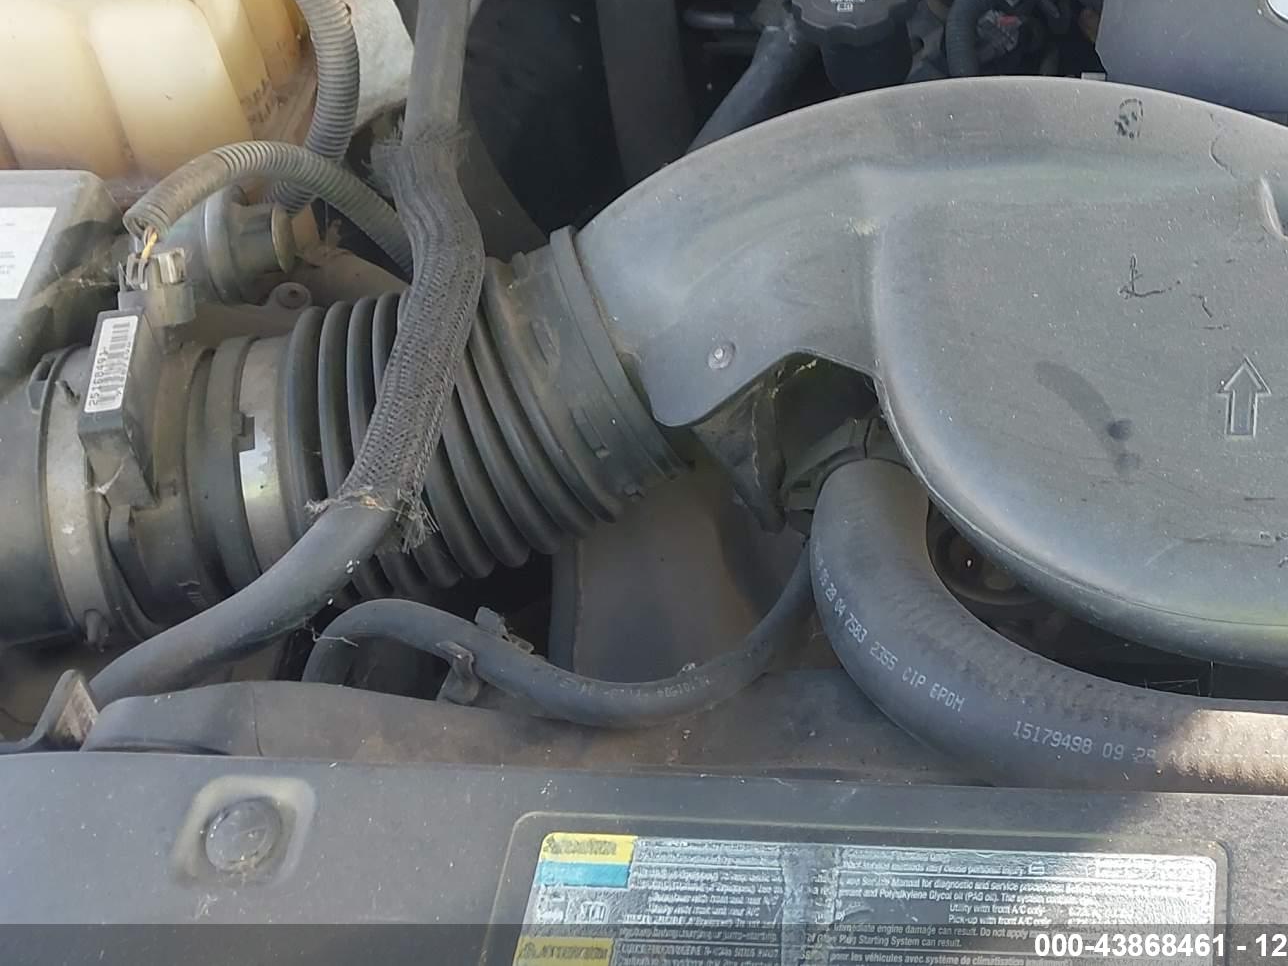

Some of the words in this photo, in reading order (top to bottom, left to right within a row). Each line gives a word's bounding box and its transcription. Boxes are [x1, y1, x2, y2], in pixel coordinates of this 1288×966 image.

[844, 612, 868, 643] 7583
[869, 641, 898, 671] 2355
[902, 666, 926, 689] CIP
[929, 683, 966, 712] EPDM
[1012, 720, 1093, 755] 15179498
[1102, 742, 1125, 761] 09
